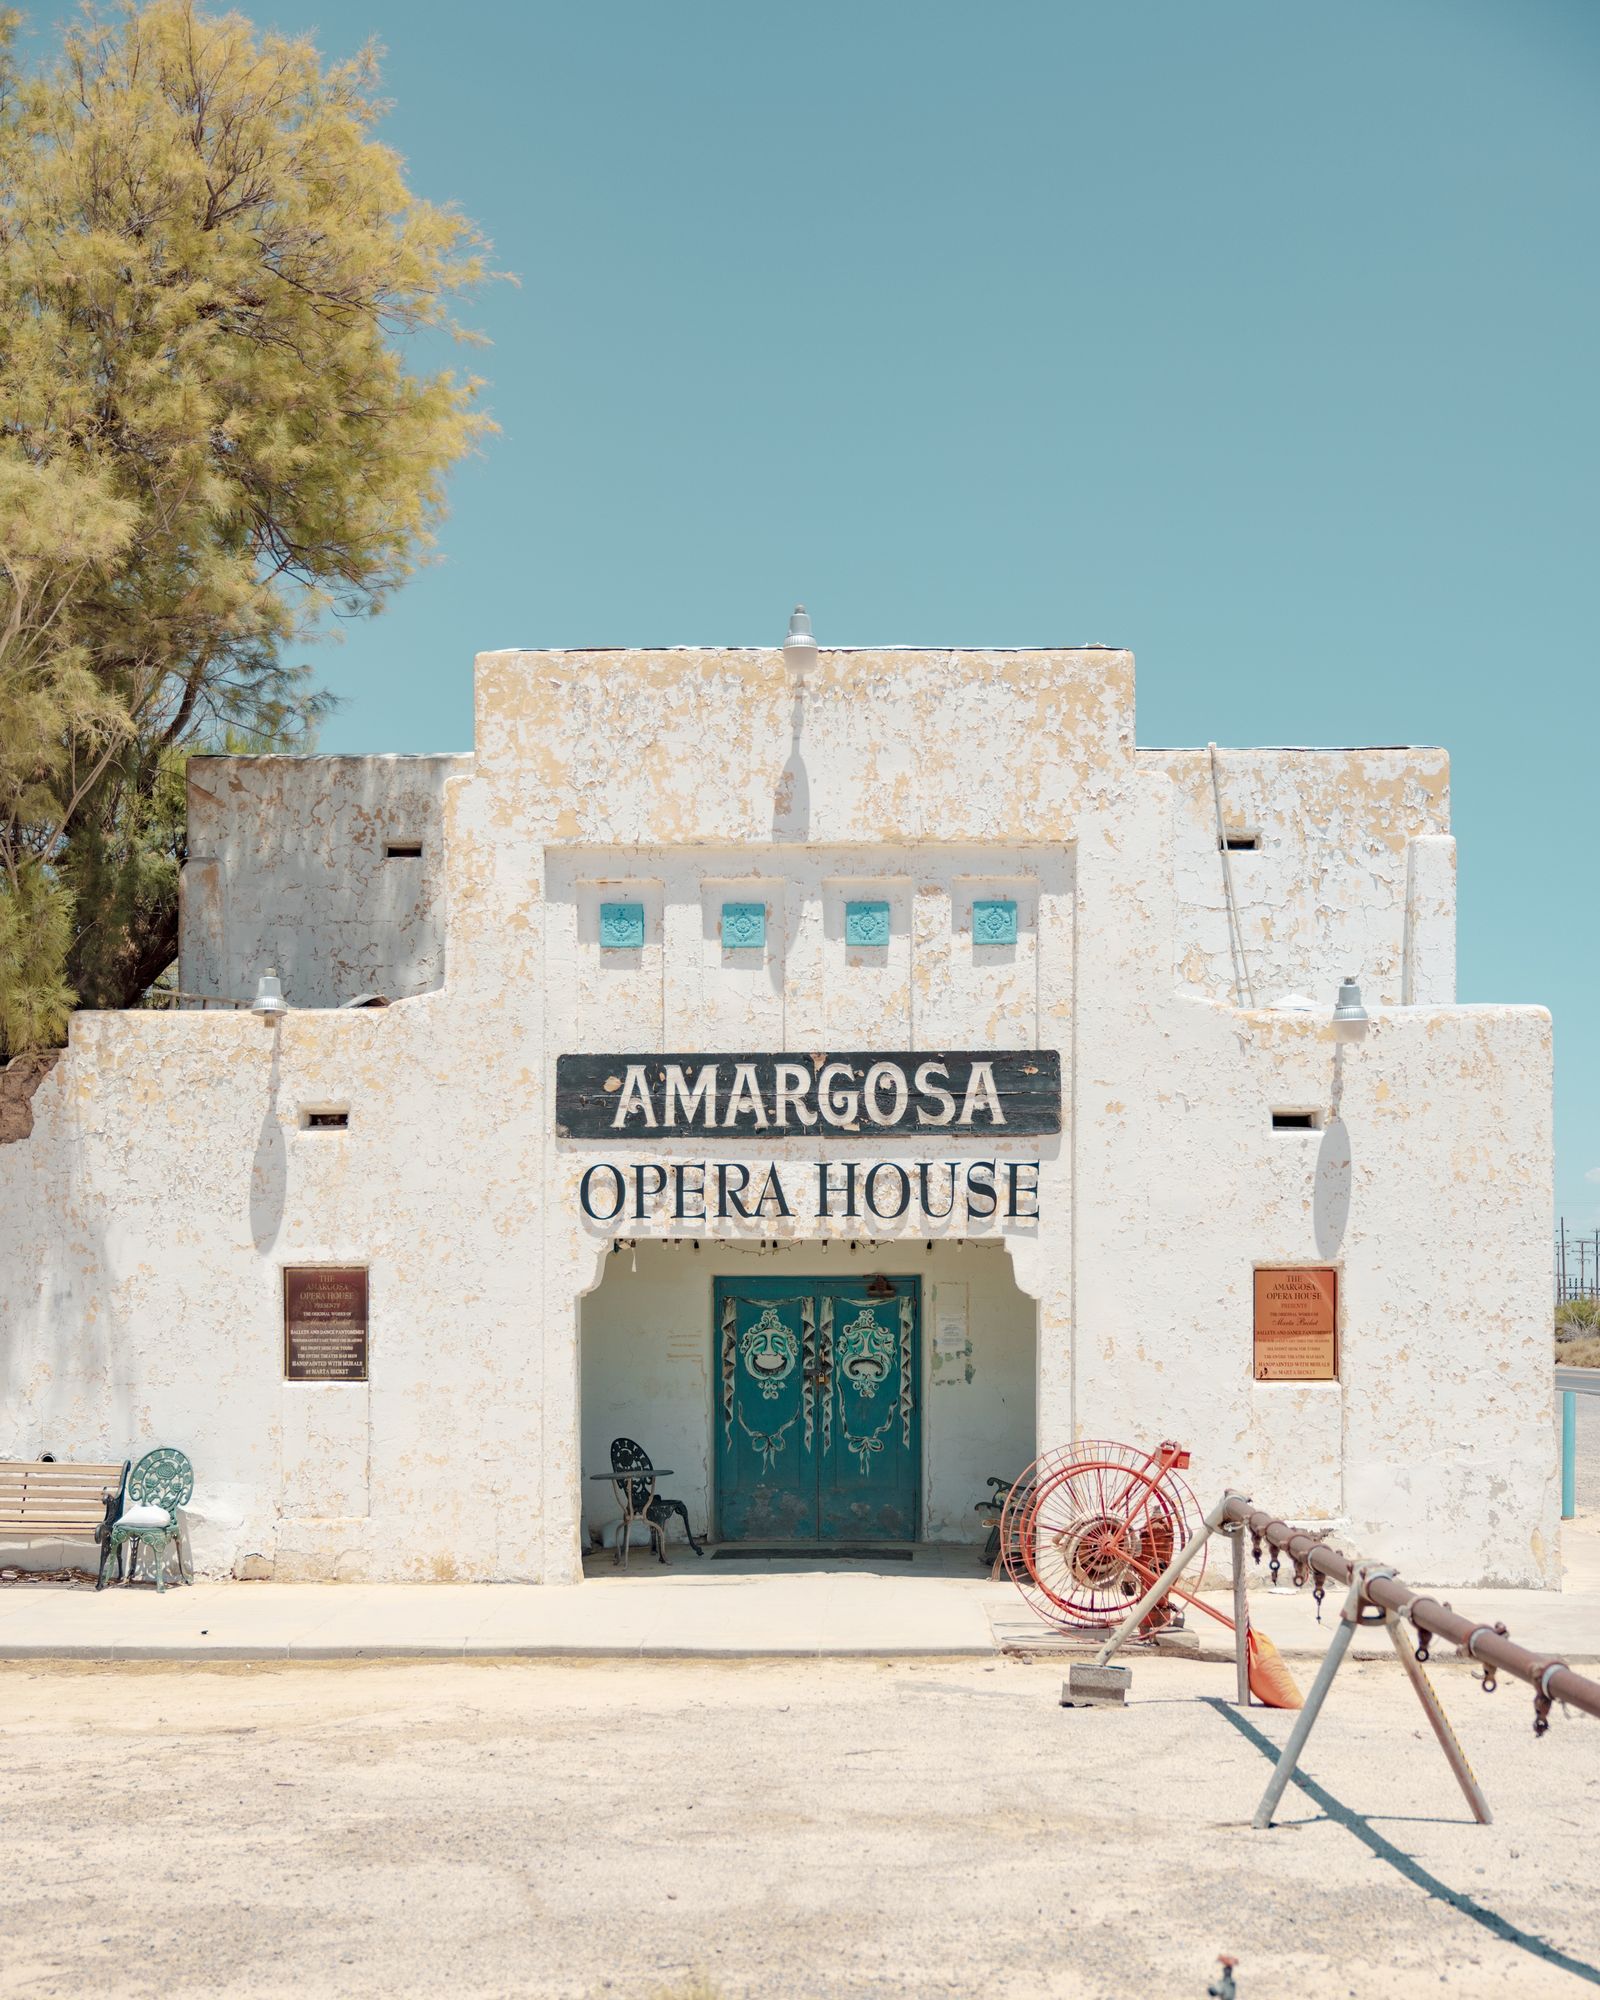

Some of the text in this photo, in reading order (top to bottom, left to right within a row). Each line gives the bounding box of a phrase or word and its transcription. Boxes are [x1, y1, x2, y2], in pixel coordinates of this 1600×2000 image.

[610, 1061, 1007, 1129] AMARGOSA
[579, 1160, 1041, 1221] OPERA HOUSE
[319, 1274, 335, 1282] THE
[1273, 1283, 1316, 1291] AMARGOSA
[300, 1292, 353, 1300] OPERA HOUSE
[1266, 1292, 1322, 1300] OPERA HOUSE
